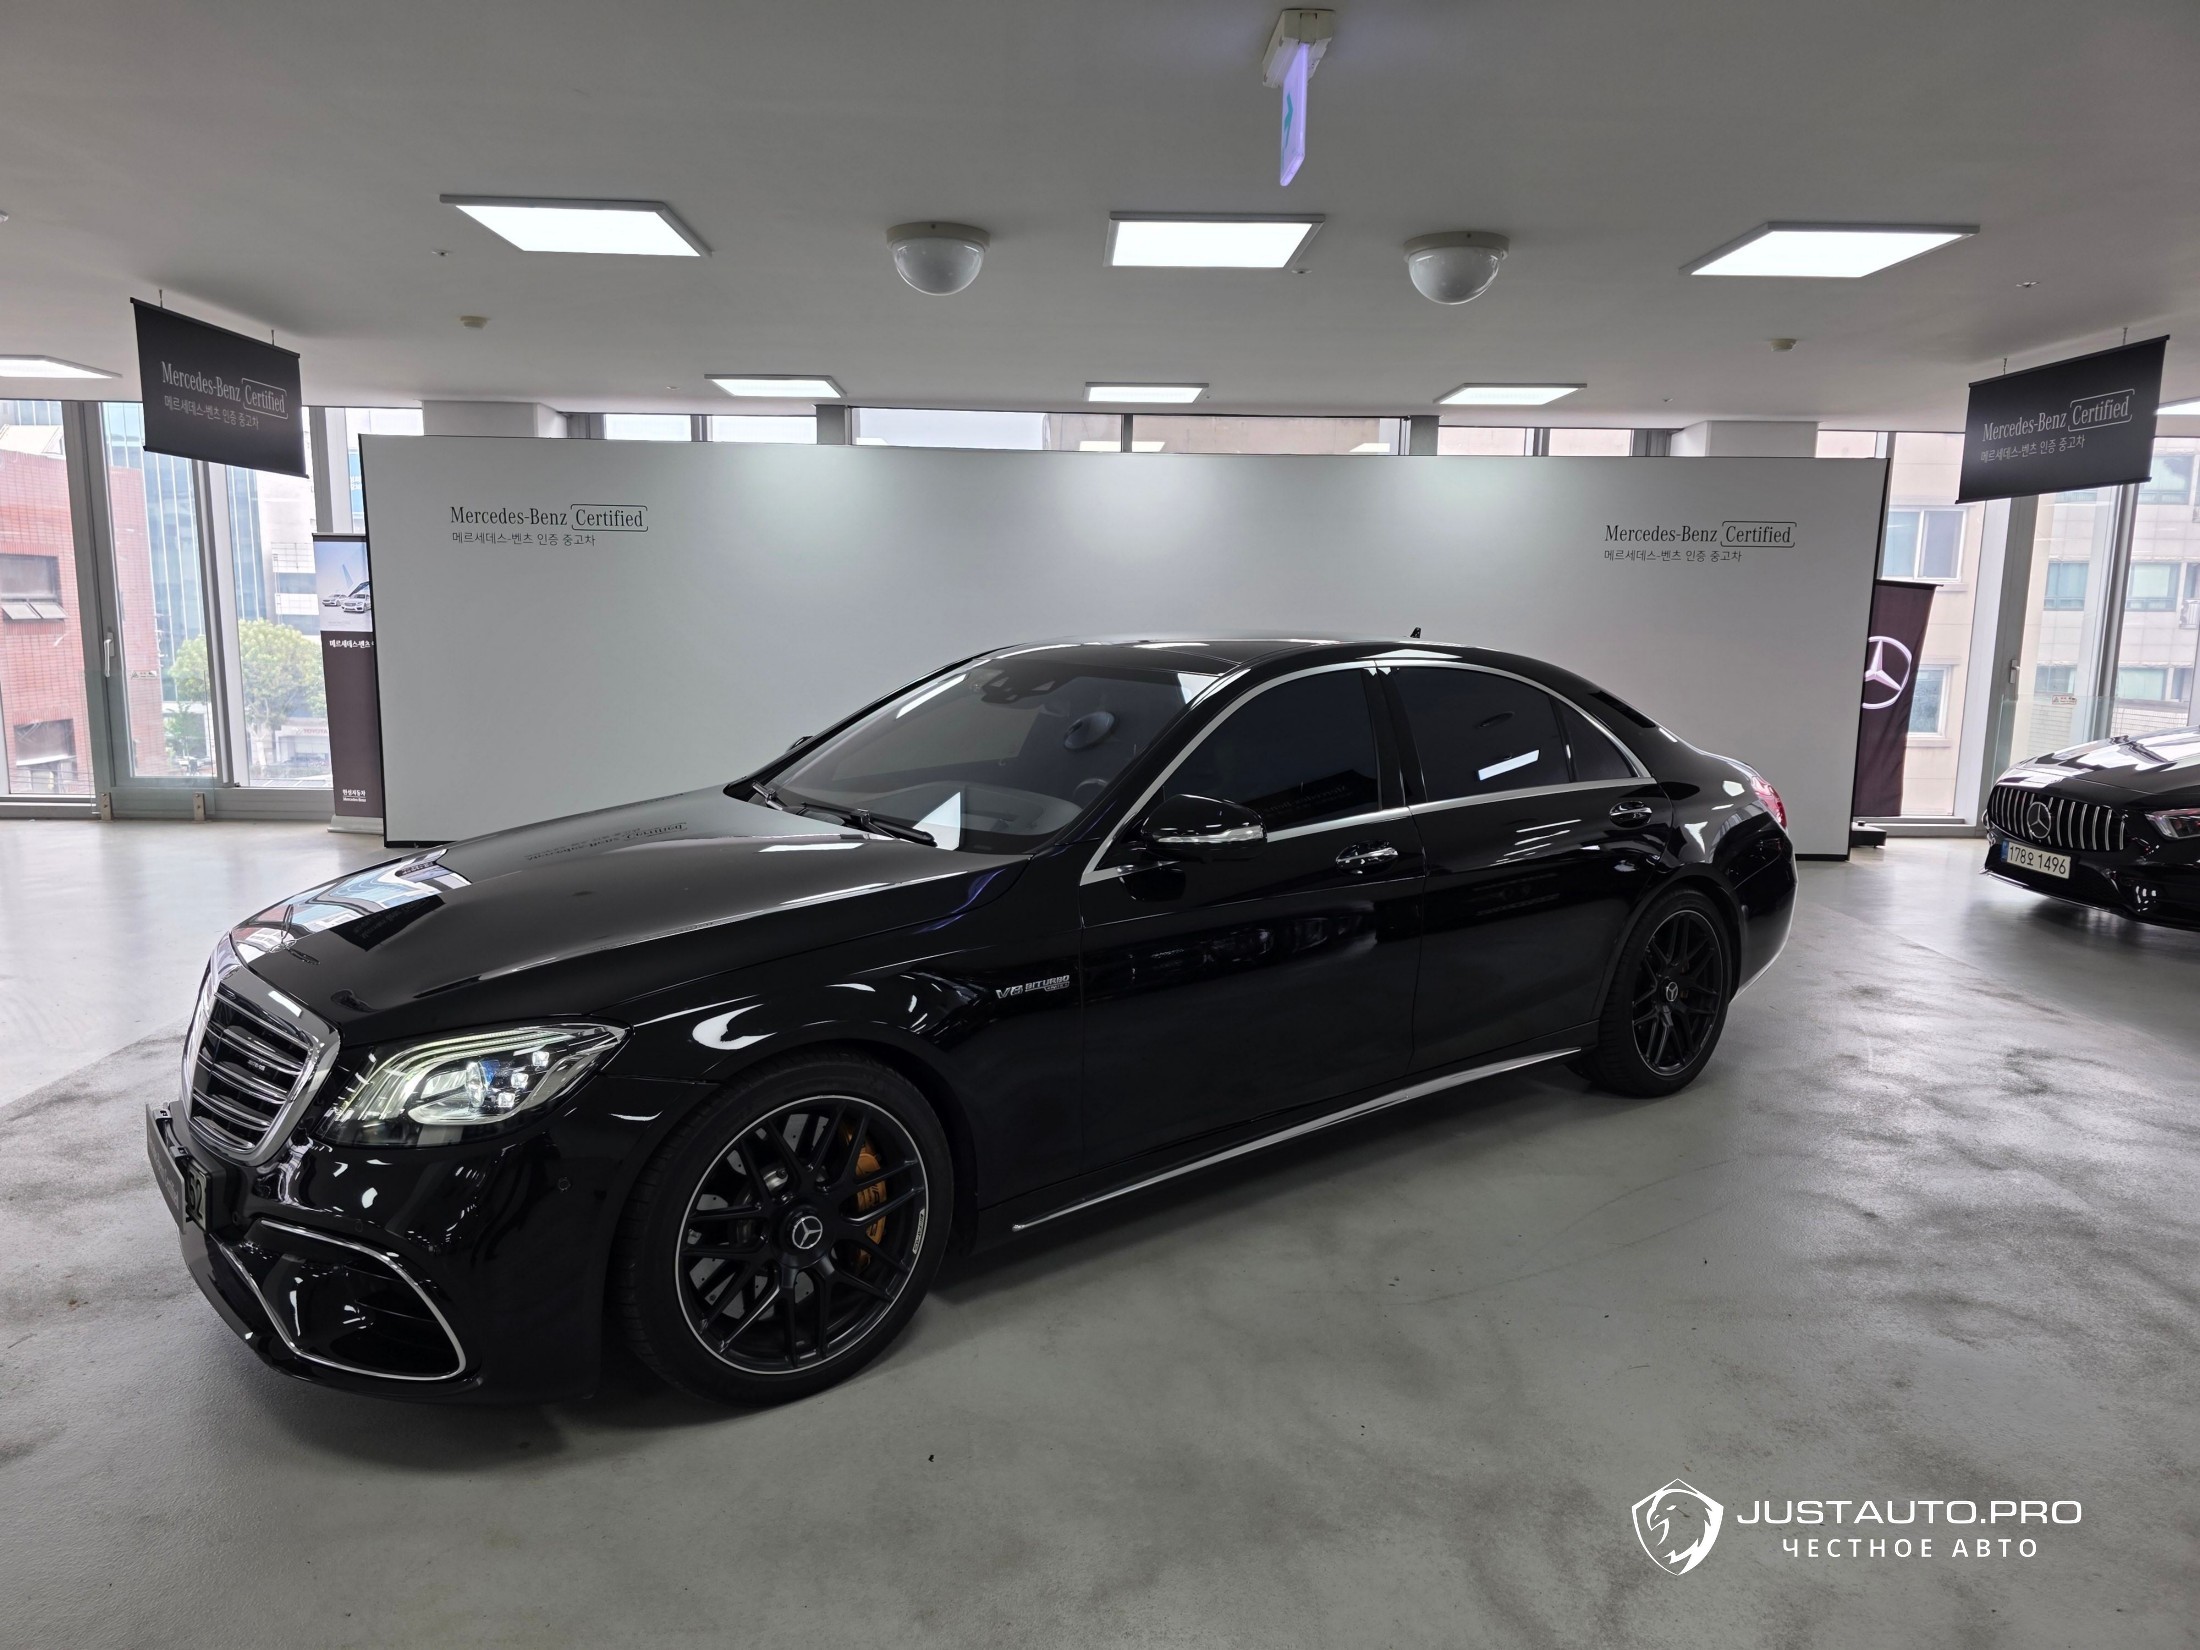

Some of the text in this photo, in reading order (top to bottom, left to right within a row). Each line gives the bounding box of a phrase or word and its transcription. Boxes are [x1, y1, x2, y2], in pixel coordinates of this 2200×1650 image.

[161, 361, 286, 413] Mercedes-Benz Certified
[164, 395, 259, 430] 메르세데스-벤츠 인증 중고차
[1982, 396, 2130, 442] Mercedes-Benz Certified
[1980, 434, 2086, 464] 메르세데스-벤츠 인증 중고차
[450, 506, 644, 527] Mercedes-Benz Certified
[452, 532, 596, 547] 메르세데스-벤츠 인증 중고차
[1604, 524, 1792, 543] Mercedes-Benz Certified
[1604, 550, 1742, 562] 메르세데스-벤츠 인증 중고차
[2009, 845, 2067, 875] 178오 1496
[995, 985, 1024, 999] V8
[1025, 975, 1070, 990] BITURBO
